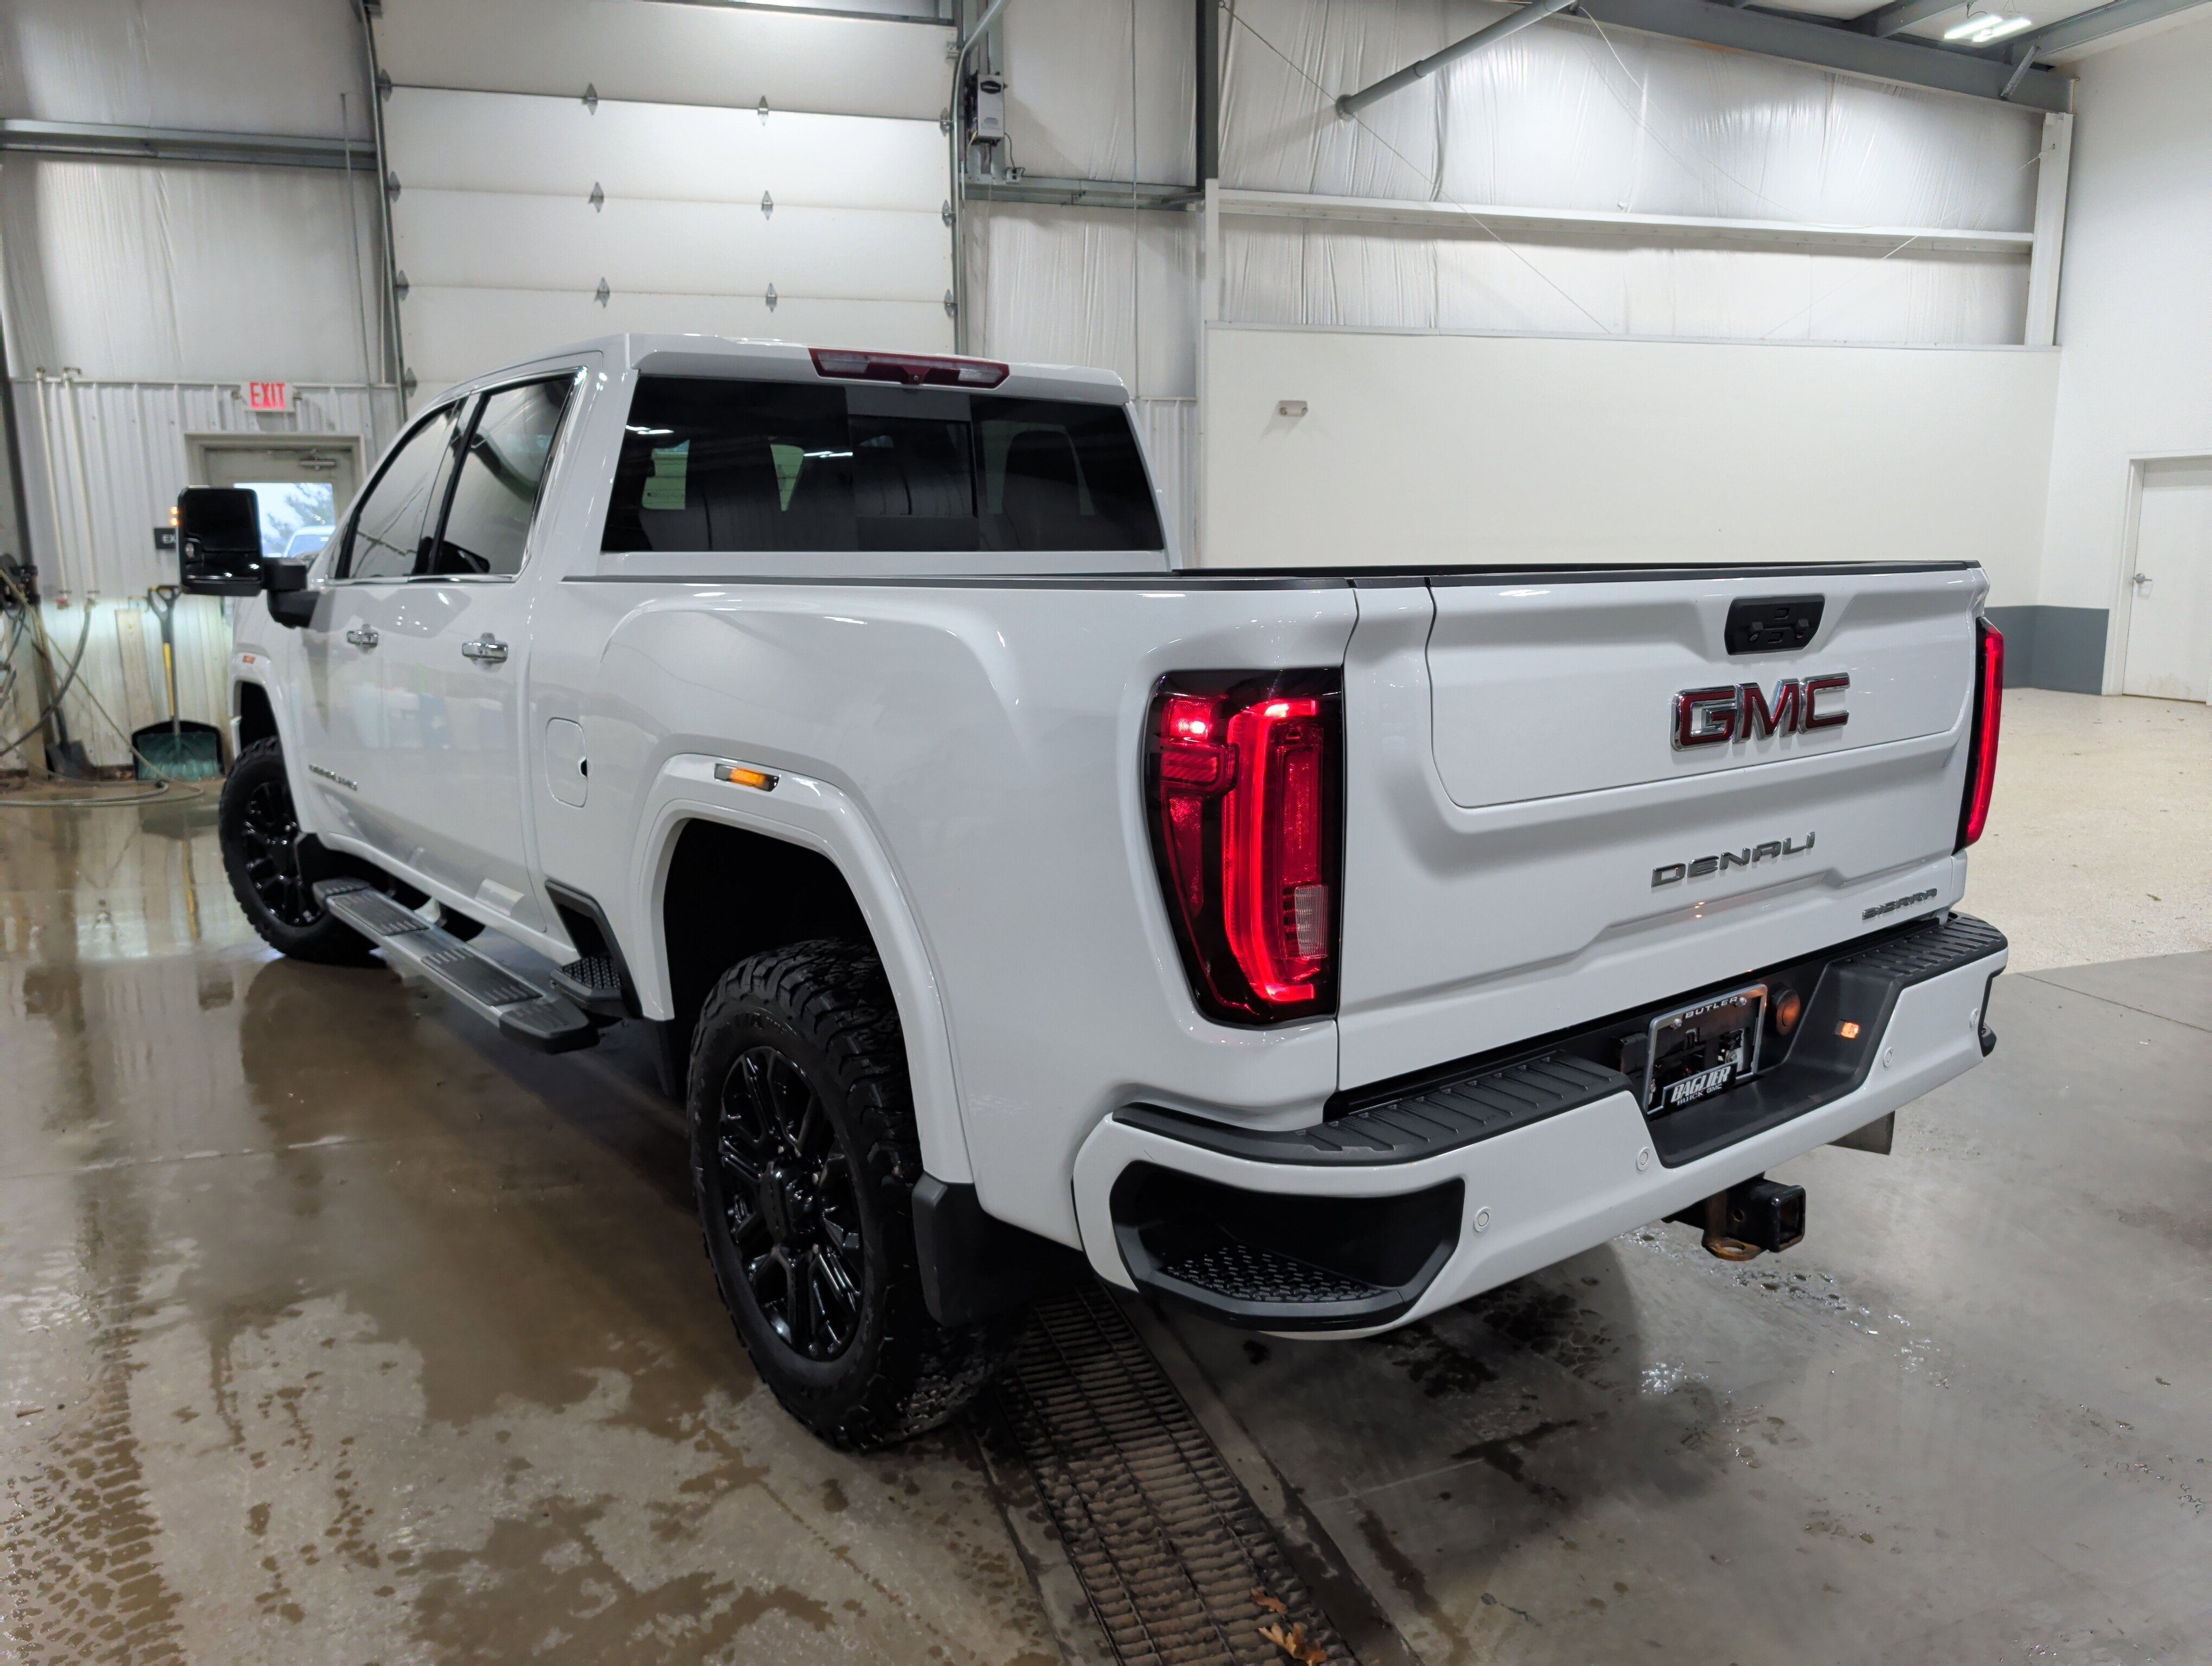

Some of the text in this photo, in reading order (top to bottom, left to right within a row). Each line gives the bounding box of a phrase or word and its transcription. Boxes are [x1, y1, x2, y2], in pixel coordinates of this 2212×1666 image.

[250, 382, 285, 409] EXIT
[1670, 672, 1850, 751] GMC
[1651, 831, 1816, 888] DENALI
[1862, 888, 1938, 920] SIERRA
[1685, 996, 1738, 1019] BUTLER
[1671, 1066, 1731, 1103] BAGLIER
[1676, 1083, 1722, 1106] BUICK GMC
